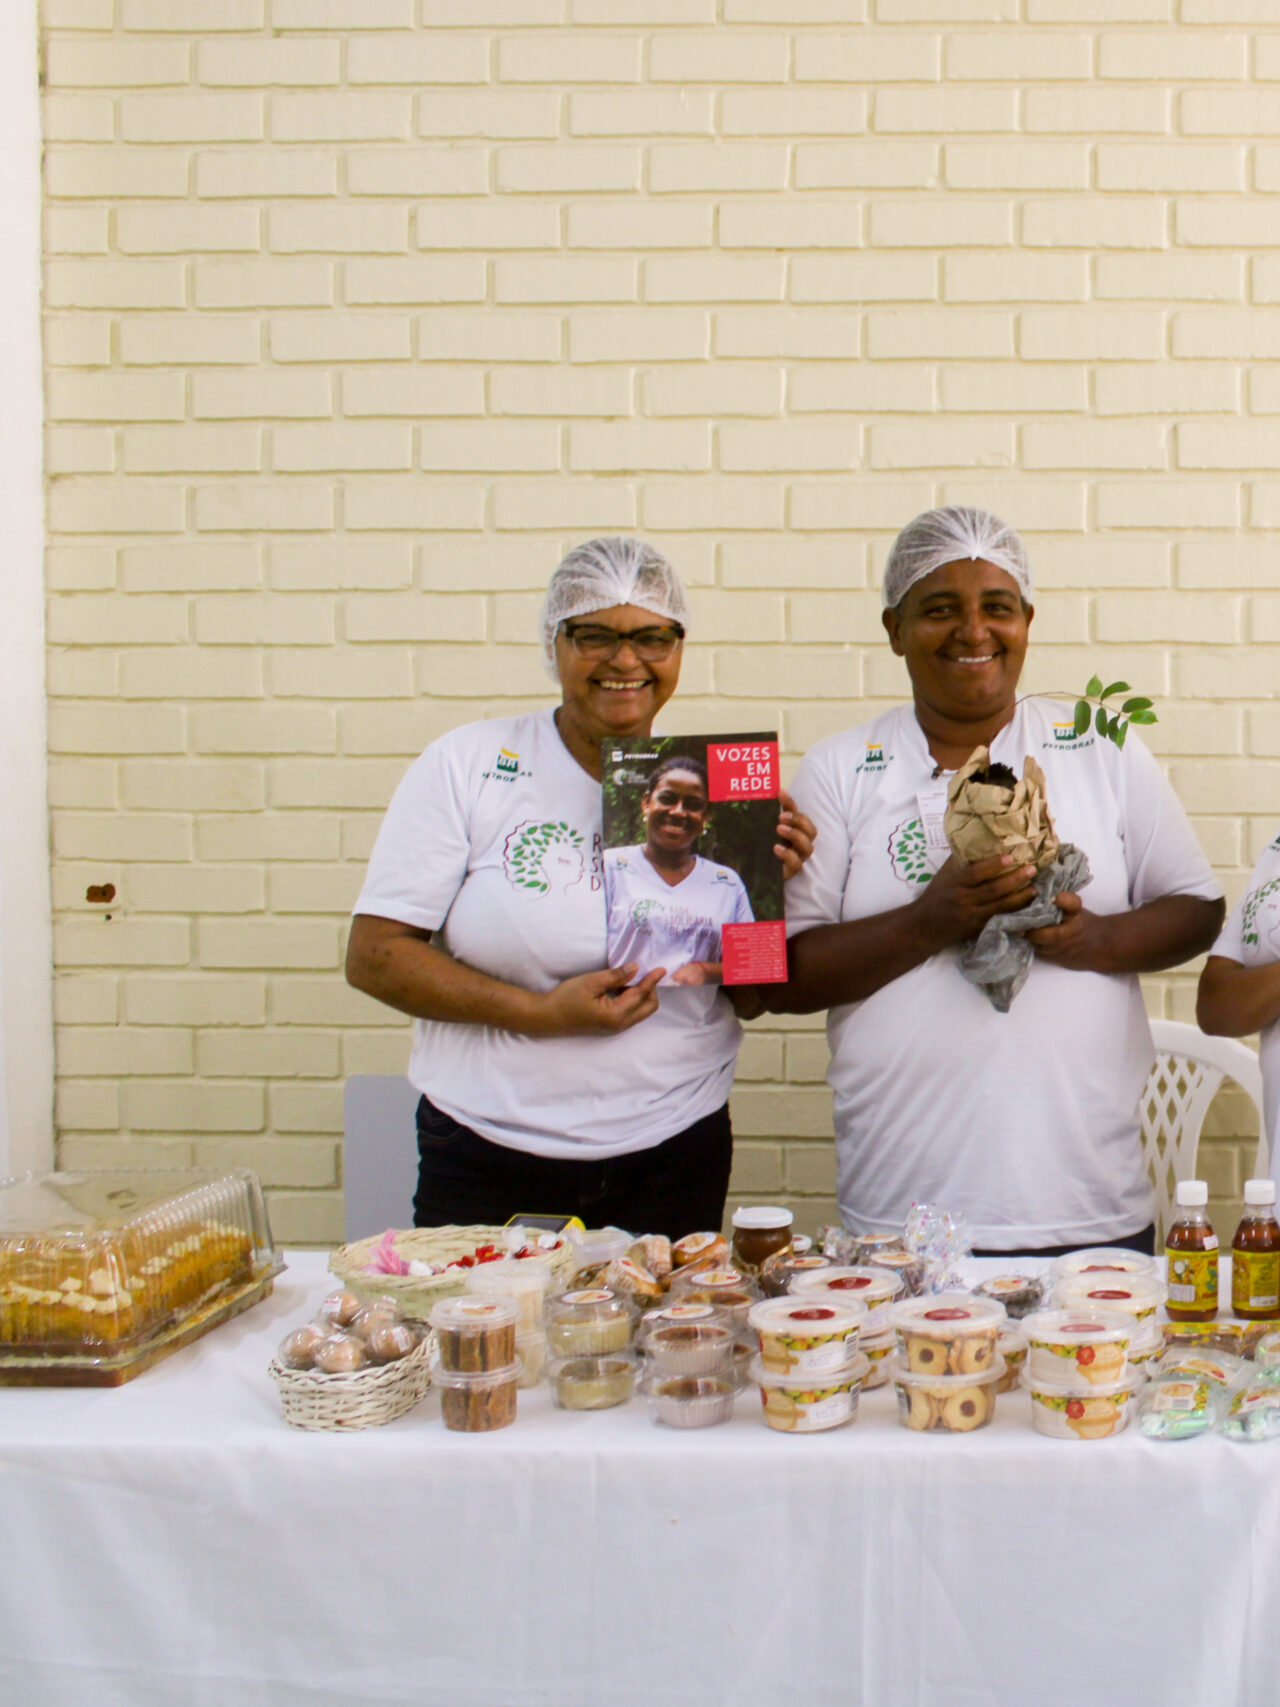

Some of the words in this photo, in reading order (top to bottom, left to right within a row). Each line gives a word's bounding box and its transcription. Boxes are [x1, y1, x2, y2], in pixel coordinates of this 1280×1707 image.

[1042, 737, 1095, 750] PETROBRAS
[716, 747, 770, 762] VOZES
[746, 762, 771, 776] EM
[730, 777, 772, 791] REDE
